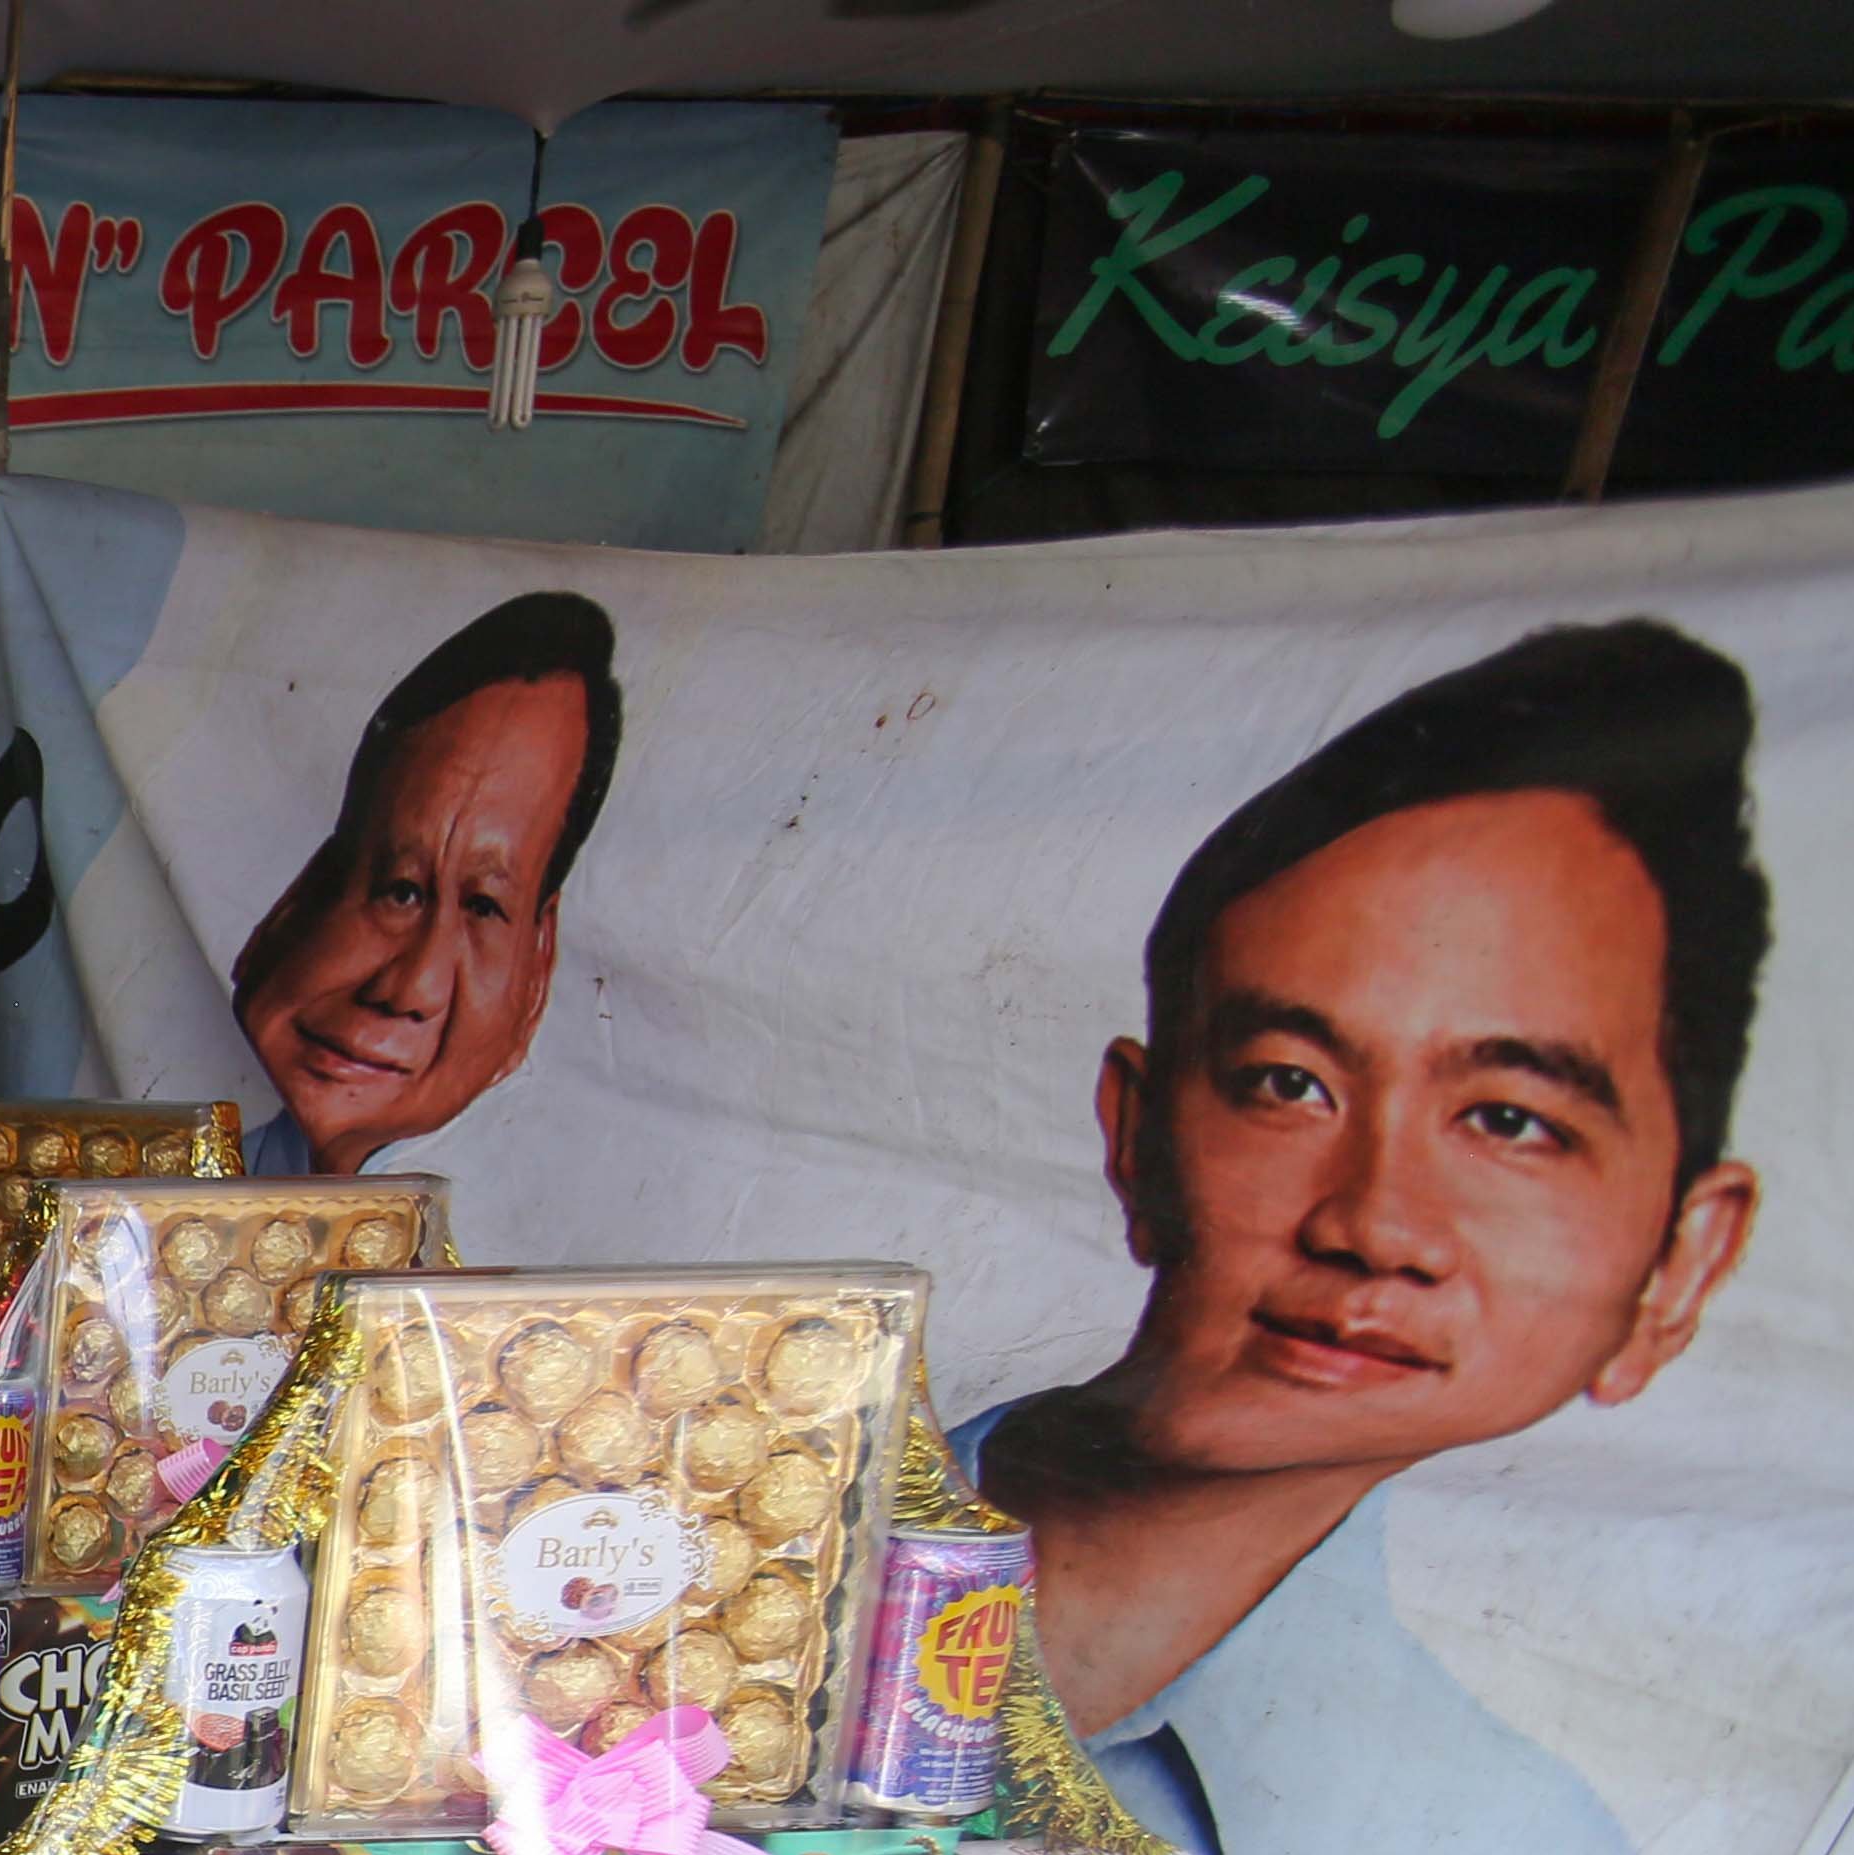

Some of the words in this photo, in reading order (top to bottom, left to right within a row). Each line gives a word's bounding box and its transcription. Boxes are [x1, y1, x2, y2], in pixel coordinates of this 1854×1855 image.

[160, 201, 770, 372] PARCEL
[188, 1367, 273, 1399] Barly's
[534, 1534, 658, 1575] Barly's
[203, 1661, 257, 1684] GRASS
[206, 1680, 250, 1702] BASIL
[251, 1678, 287, 1701] SEED
